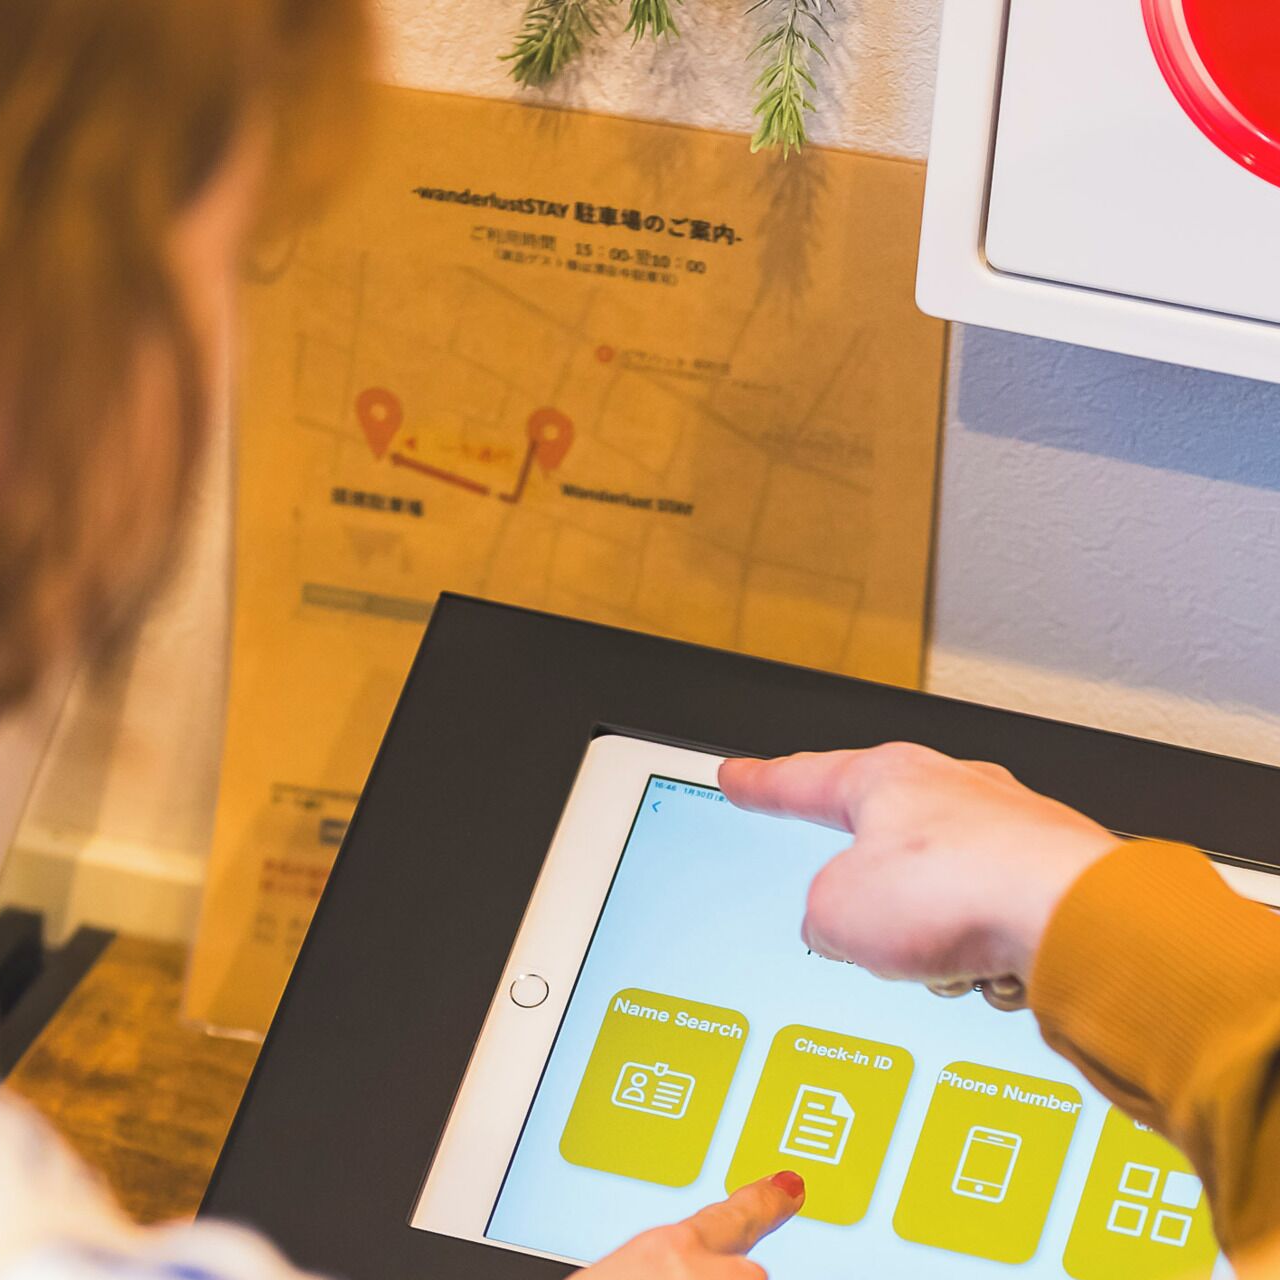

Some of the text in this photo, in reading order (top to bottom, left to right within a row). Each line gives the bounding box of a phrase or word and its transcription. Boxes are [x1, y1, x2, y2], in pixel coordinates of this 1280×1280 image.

[613, 997, 743, 1040] Name Search
[794, 1038, 893, 1071] Check-in ID
[937, 1070, 1083, 1115] Phone Number
